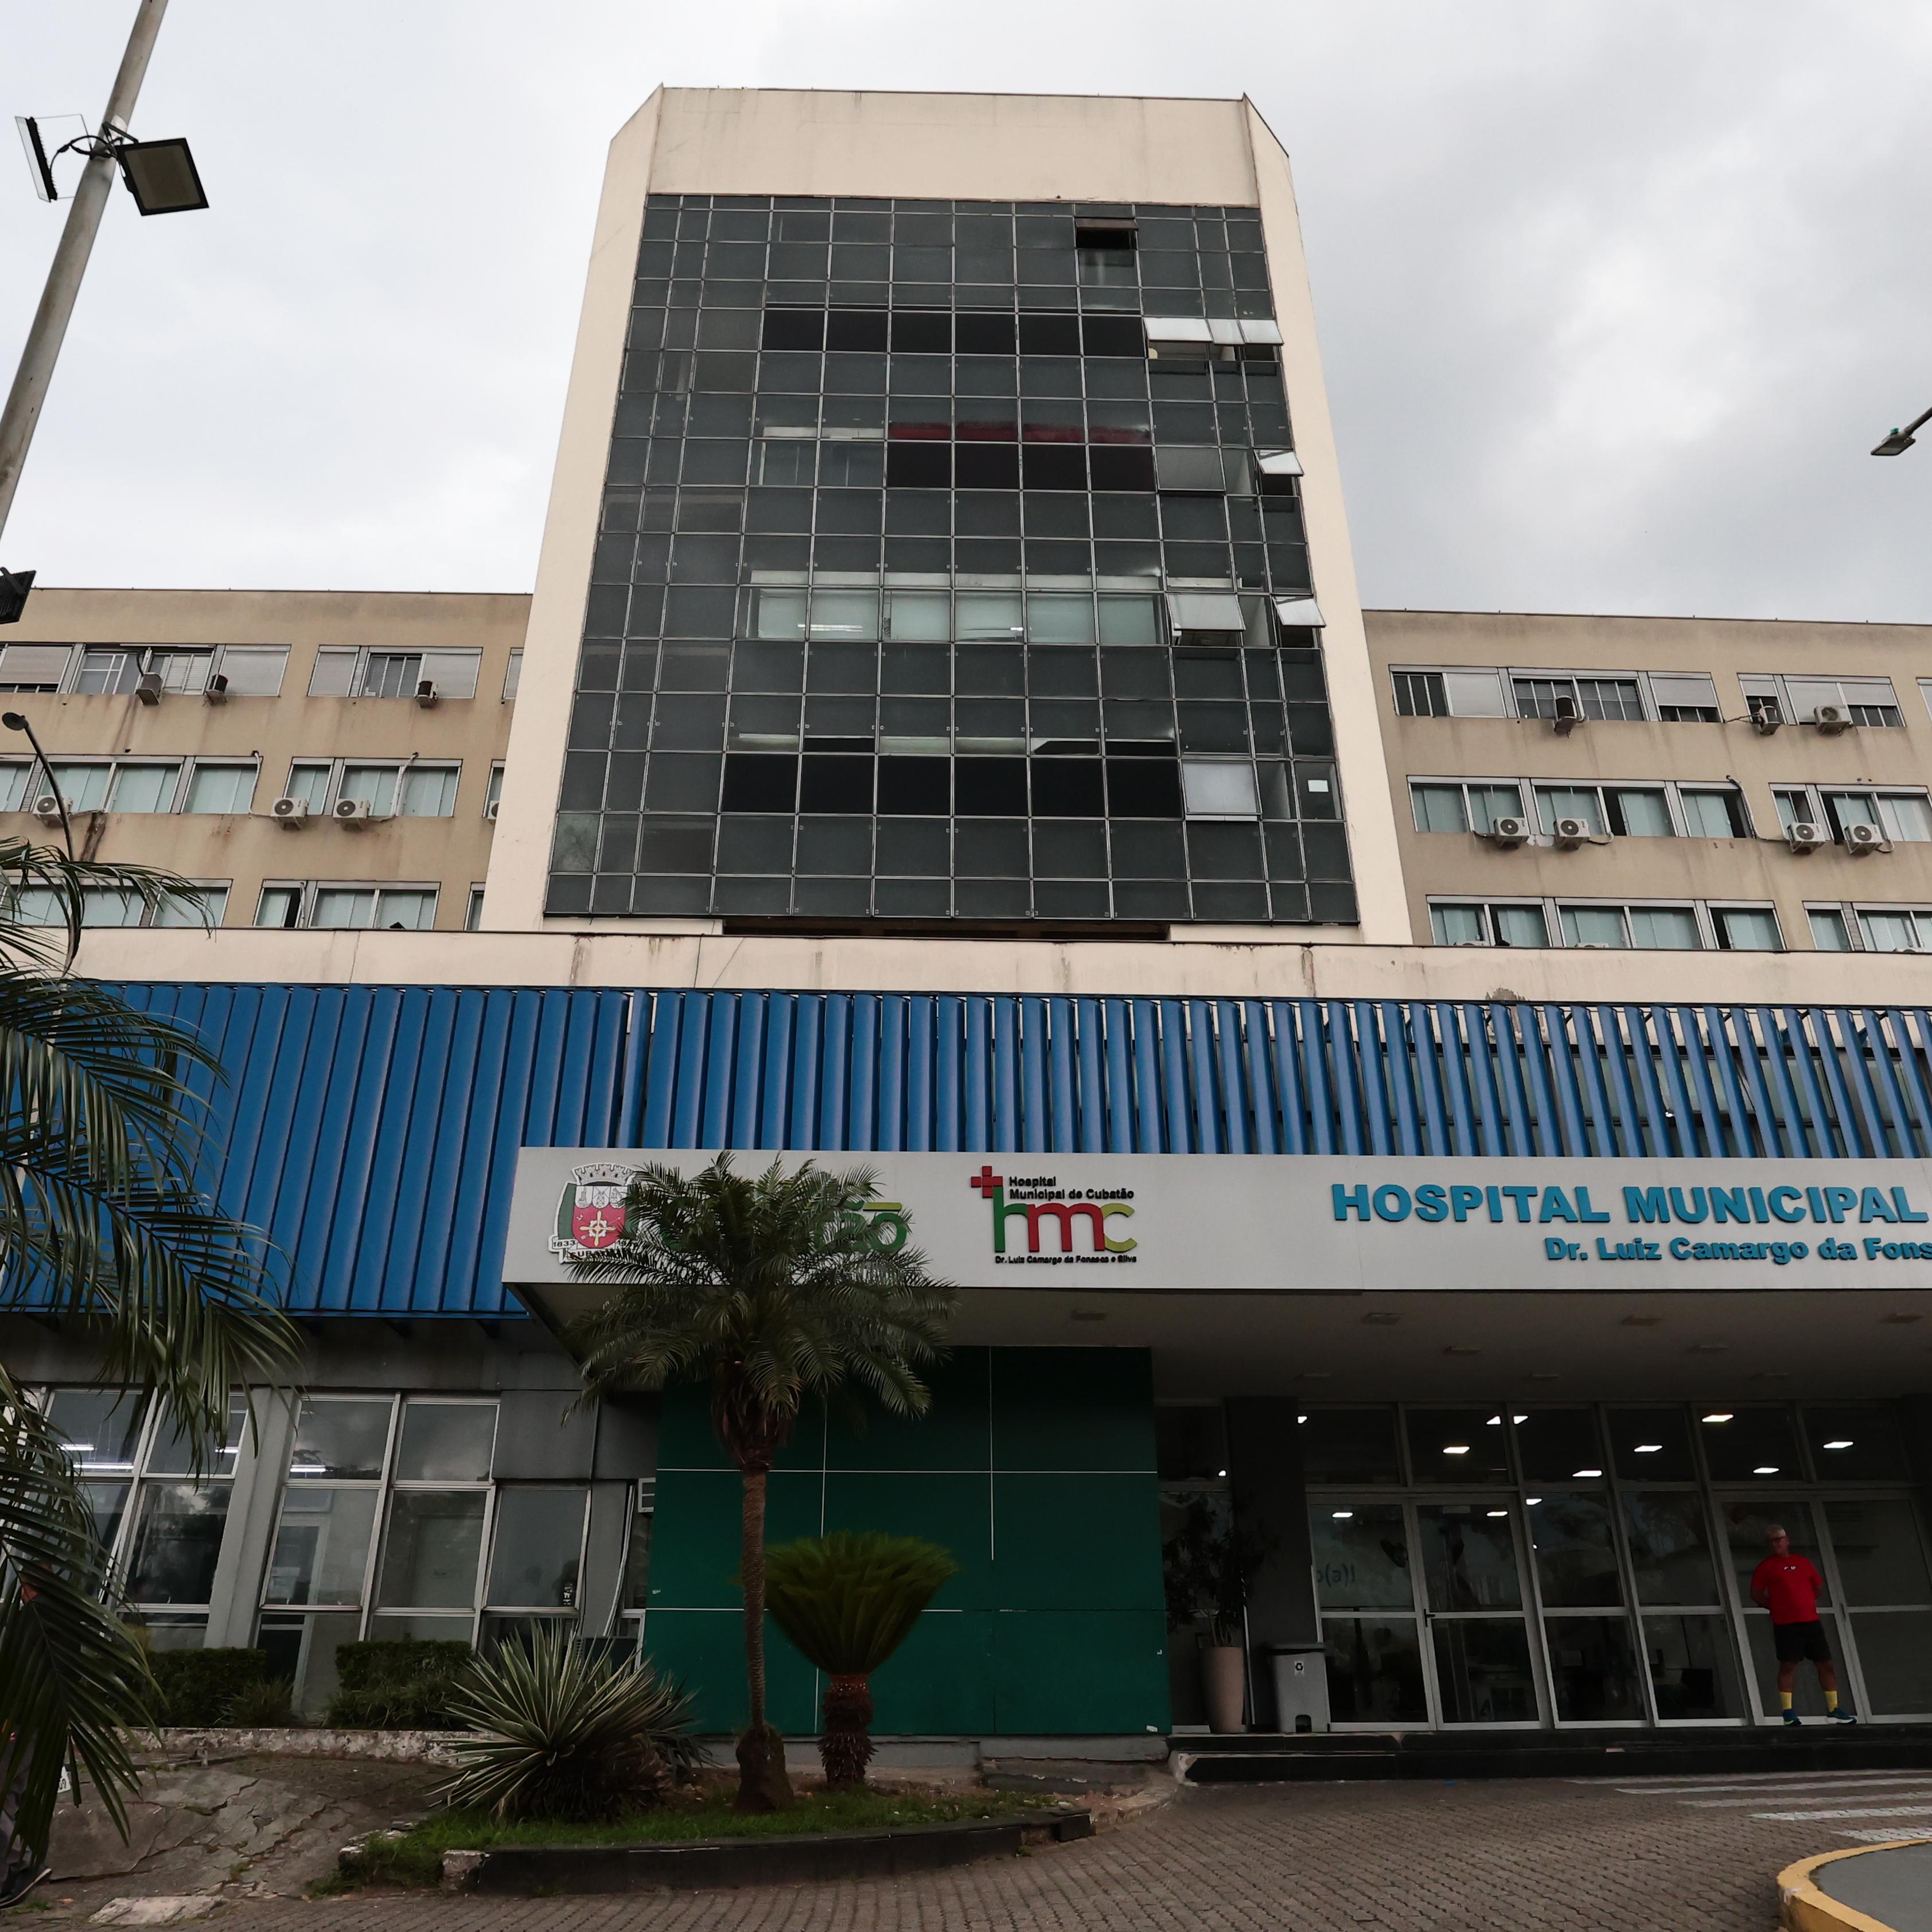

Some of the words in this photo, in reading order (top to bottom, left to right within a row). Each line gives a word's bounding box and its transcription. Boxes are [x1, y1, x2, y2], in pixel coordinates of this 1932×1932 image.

[1009, 1176, 1056, 1189] Hospital
[1010, 1189, 1065, 1201] Municipal
[1069, 1189, 1082, 1199] de
[1086, 1188, 1135, 1199] Cubatão
[1331, 1184, 1610, 1222] HOSPITAL
[1623, 1186, 1930, 1223] MUNICIPAL
[992, 1186, 1138, 1253] hmc
[995, 1256, 1007, 1264] Dr.
[1008, 1256, 1025, 1264] Luiz
[1027, 1256, 1062, 1265] Camargo
[1064, 1255, 1074, 1263] da
[1545, 1237, 1588, 1261] Dr.
[1596, 1237, 1662, 1260] Luiz
[1670, 1237, 1809, 1265] Camargo
[1818, 1237, 1857, 1260] da
